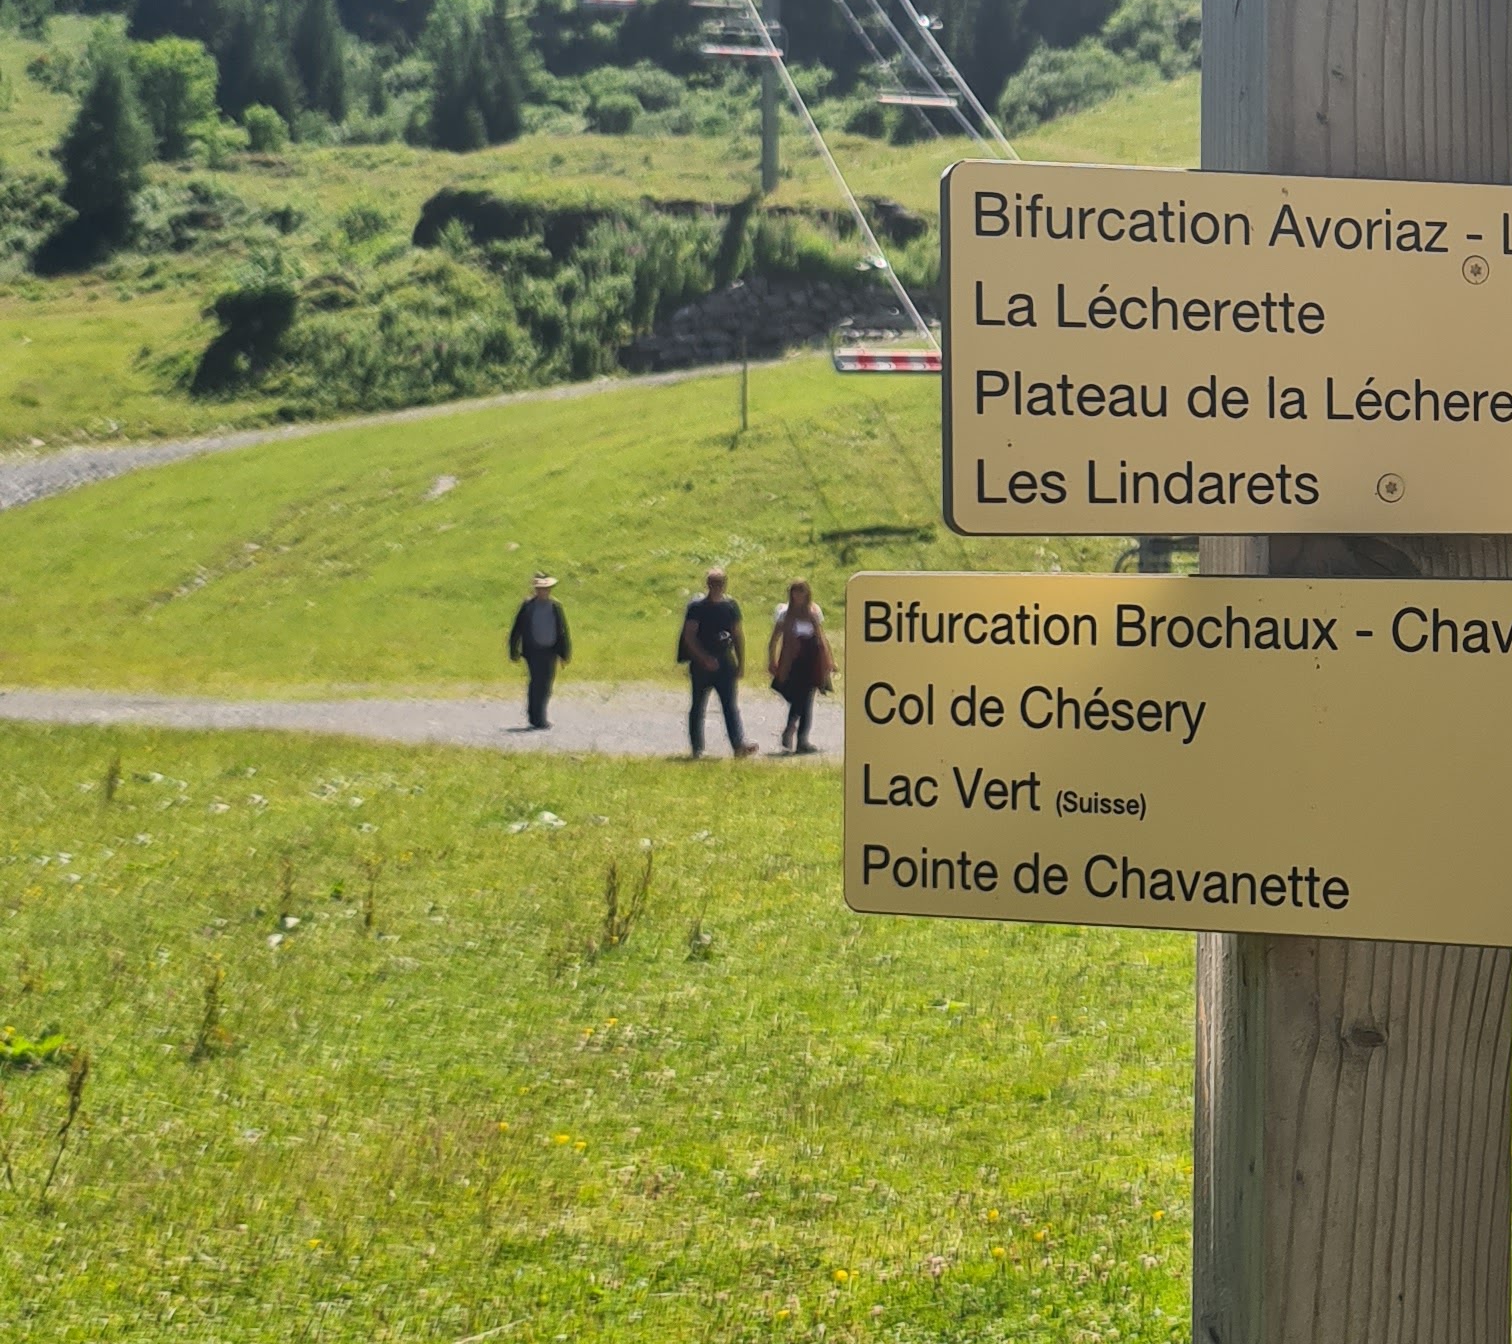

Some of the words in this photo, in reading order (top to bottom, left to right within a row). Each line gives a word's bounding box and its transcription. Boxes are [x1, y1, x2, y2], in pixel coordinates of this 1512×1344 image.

[974, 191, 1251, 246] Bifurcation
[1268, 203, 1449, 253] Avoriaz
[1465, 233, 1483, 241] -
[975, 280, 1038, 328] La
[1057, 283, 1325, 335] Lécherette
[976, 369, 1168, 418] Plateau
[1187, 374, 1250, 420] de
[1267, 375, 1308, 420] la
[976, 458, 1067, 505] Les
[1088, 459, 1320, 505] Lindarets
[864, 600, 1097, 646] Bifurcation
[1116, 603, 1339, 651] Brochaux
[863, 681, 934, 726] Col
[950, 684, 1005, 728] de
[1019, 685, 1207, 745] Chésery
[863, 763, 939, 808] Lac
[952, 766, 1041, 812] Vert
[1055, 789, 1147, 822] (Suisse)
[863, 843, 999, 893] Pointe
[1013, 851, 1069, 896] de
[1084, 854, 1350, 910] Chavanette
